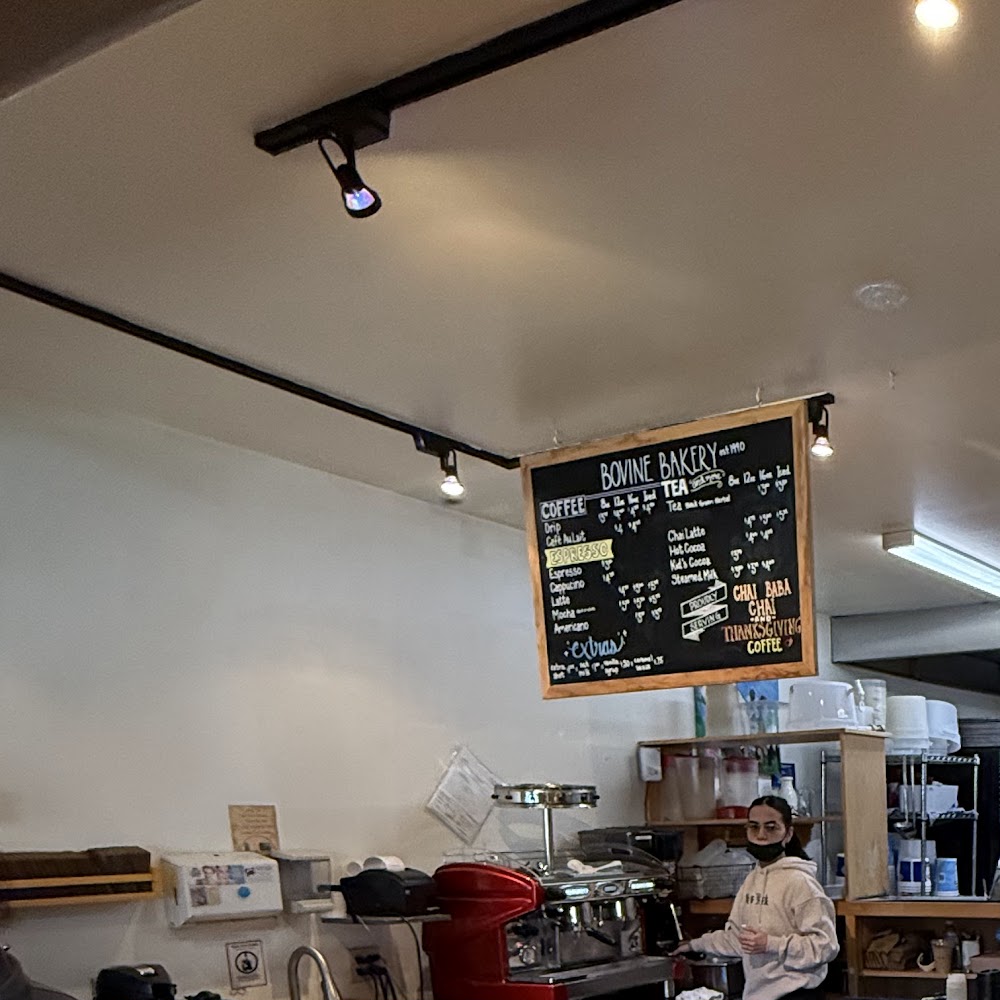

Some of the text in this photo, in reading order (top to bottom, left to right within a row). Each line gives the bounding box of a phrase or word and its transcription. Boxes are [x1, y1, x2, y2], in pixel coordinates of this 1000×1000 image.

[600, 454, 654, 491] BOVINE
[658, 441, 718, 480] BAKERY
[661, 478, 689, 498] TEA
[541, 497, 586, 519] COFFEE
[666, 500, 682, 512] Tea
[548, 567, 583, 580] Espresso
[733, 578, 792, 602] CHAI BABA
[748, 598, 776, 617] CHAI
[721, 617, 802, 642] THANKSGIVING
[569, 636, 625, 660] extras
[747, 637, 783, 655] COFFEE
